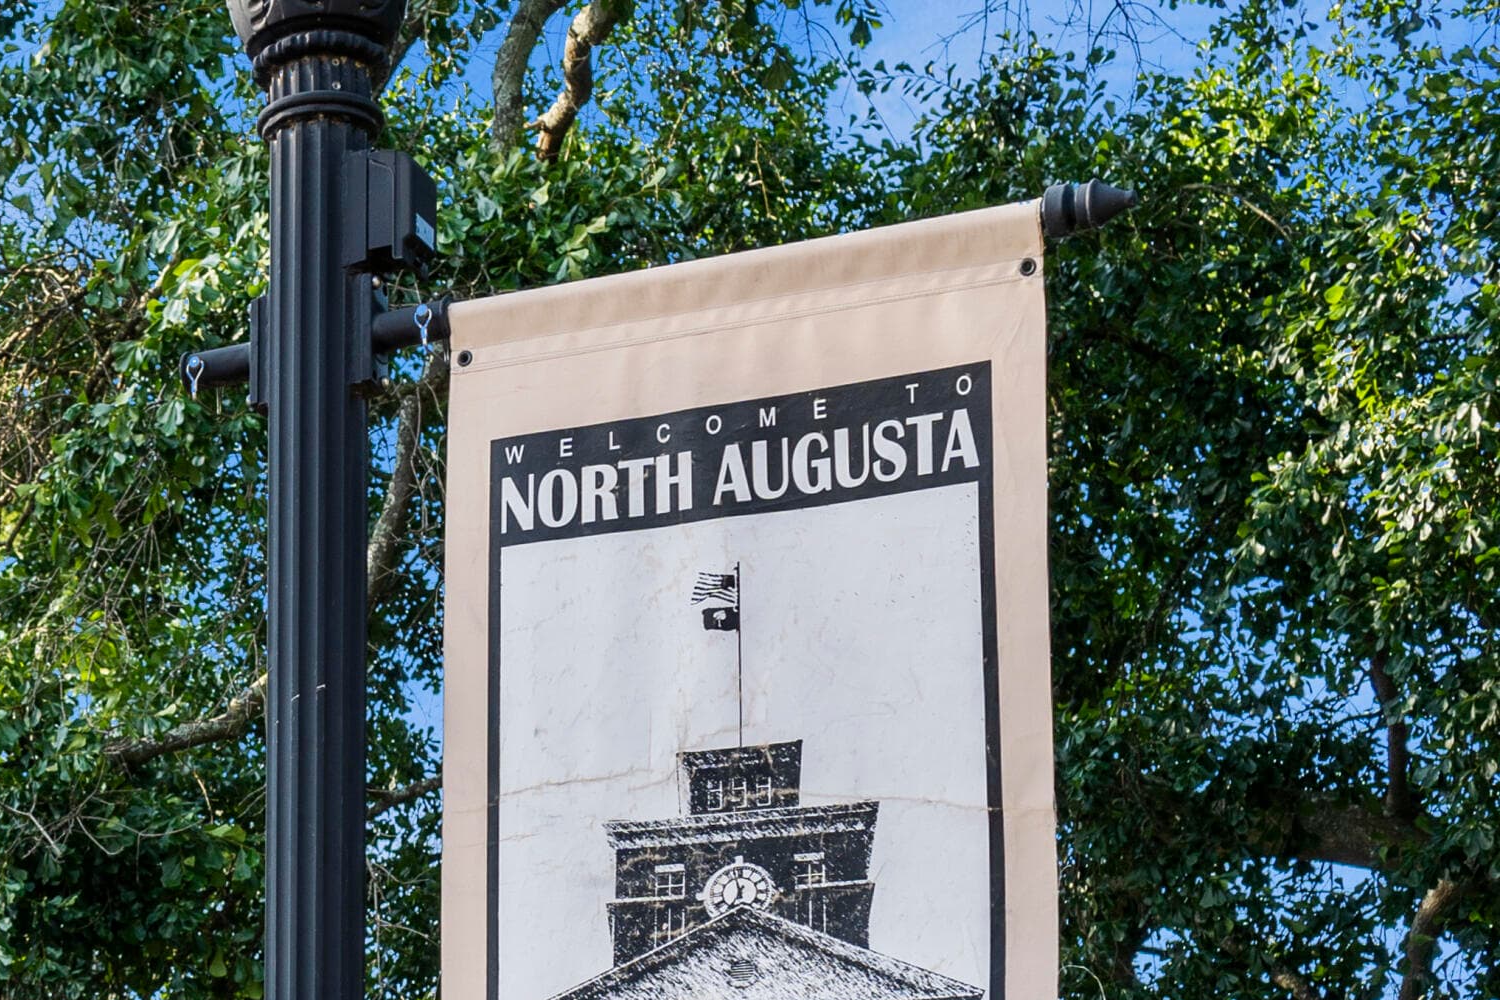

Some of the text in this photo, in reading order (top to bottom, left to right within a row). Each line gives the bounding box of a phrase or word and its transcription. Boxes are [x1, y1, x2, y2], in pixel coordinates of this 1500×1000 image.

[500, 407, 980, 534] NORTH AUGUSTA
[505, 375, 972, 464] WELCOME TO
